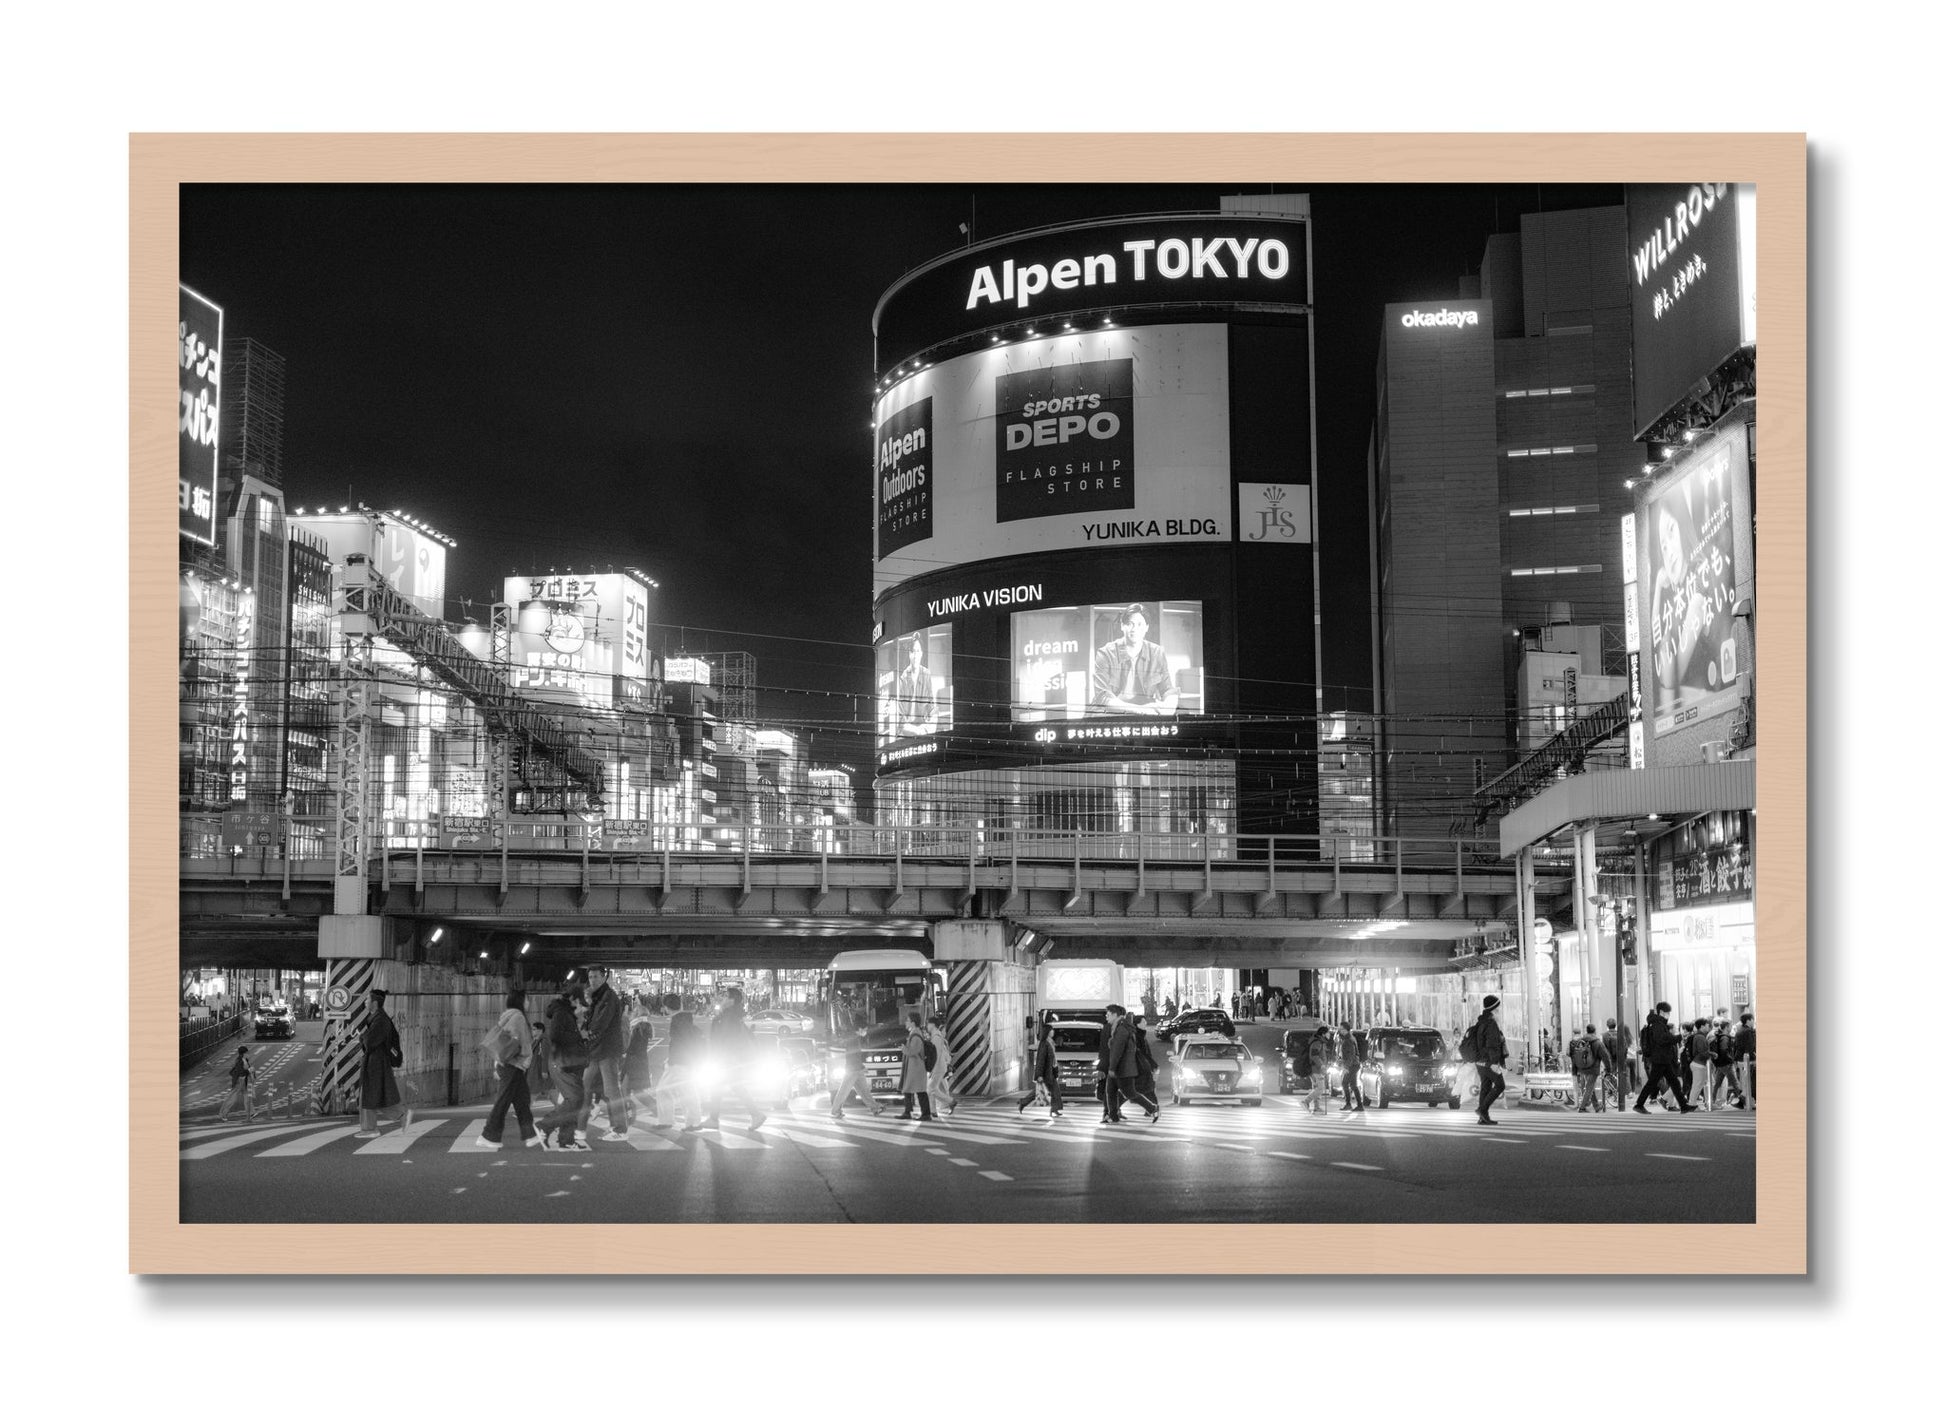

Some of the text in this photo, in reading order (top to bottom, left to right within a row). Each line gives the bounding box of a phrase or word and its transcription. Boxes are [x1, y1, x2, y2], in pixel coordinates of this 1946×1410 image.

[966, 237, 1290, 310] Alpen TOKYO
[1401, 308, 1479, 329] okadaya
[179, 388, 217, 447] スパス
[1023, 393, 1101, 417] SPORTS
[1006, 411, 1121, 451] DEPO
[880, 427, 926, 472] Alpen
[882, 464, 925, 505] Outdoors
[1006, 459, 1121, 483] FLAGSHIP
[1047, 477, 1121, 494] STORE
[879, 492, 927, 525] FLAGSHIP
[892, 508, 927, 532] STORE
[1082, 518, 1221, 541] YUNIKA BLDG.
[297, 584, 327, 605] SHISHA
[530, 578, 599, 600] プロミス
[927, 583, 1043, 618] YUNIKA VISION
[1651, 544, 1731, 649] 自分本位でも、
[625, 595, 645, 668] プロミス
[1654, 582, 1736, 678] いいじゃない。
[1023, 639, 1079, 657] dream
[1034, 725, 1179, 743] dip 夢を叶える仕事に出会おう
